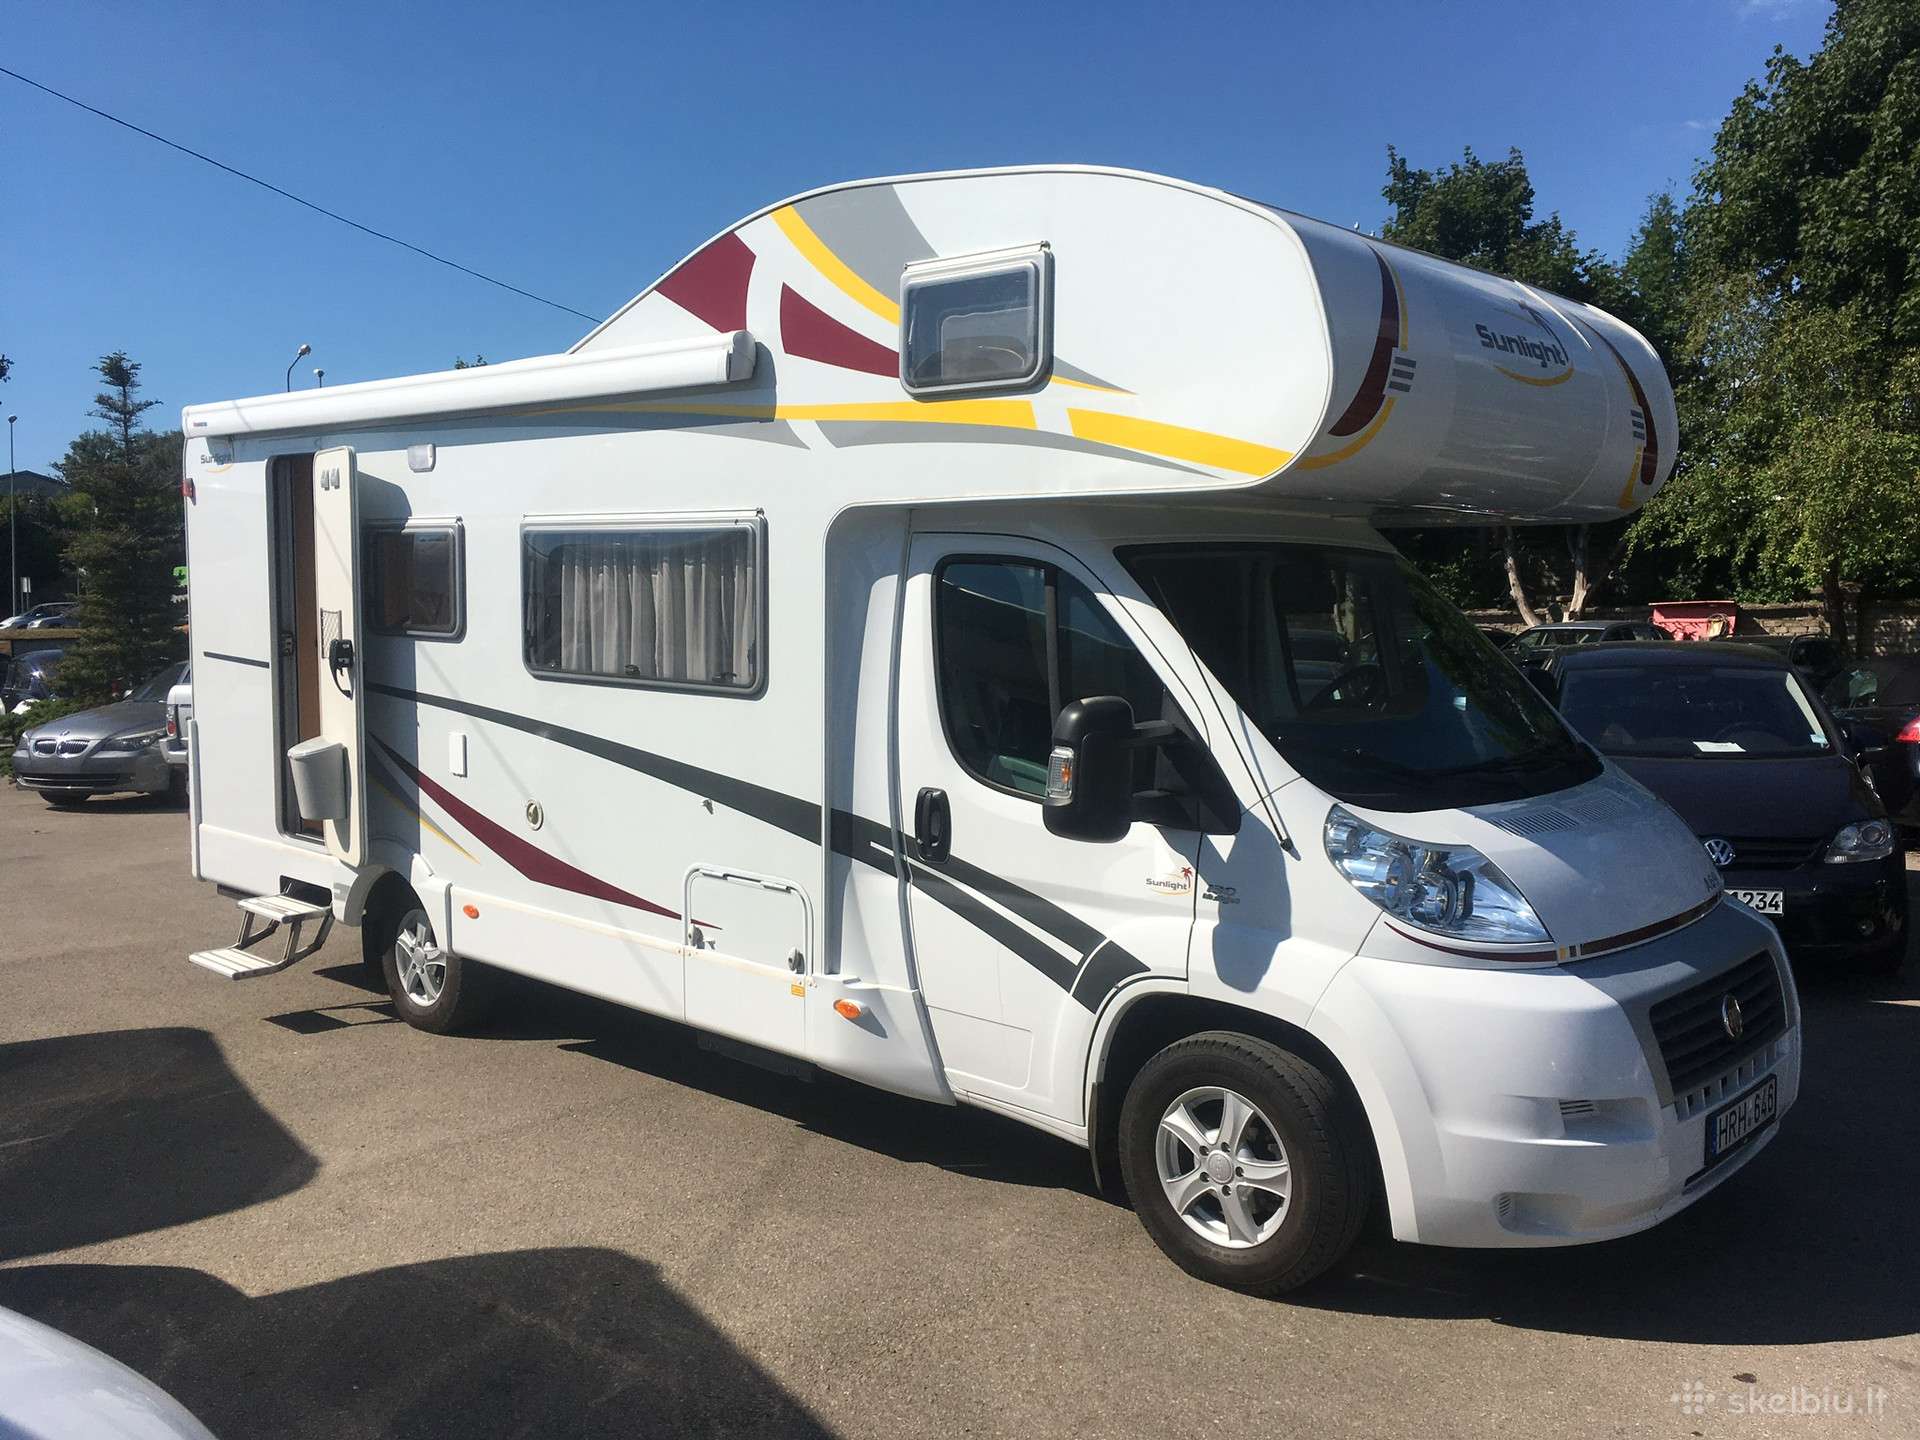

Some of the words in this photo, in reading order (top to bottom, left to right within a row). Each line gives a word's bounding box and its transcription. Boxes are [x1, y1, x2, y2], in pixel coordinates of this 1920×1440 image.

[1475, 323, 1567, 368] Sunlight
[1145, 877, 1188, 891] Sunlight
[1718, 1102, 1747, 1149] HRH
[1753, 1083, 1774, 1123] 646
